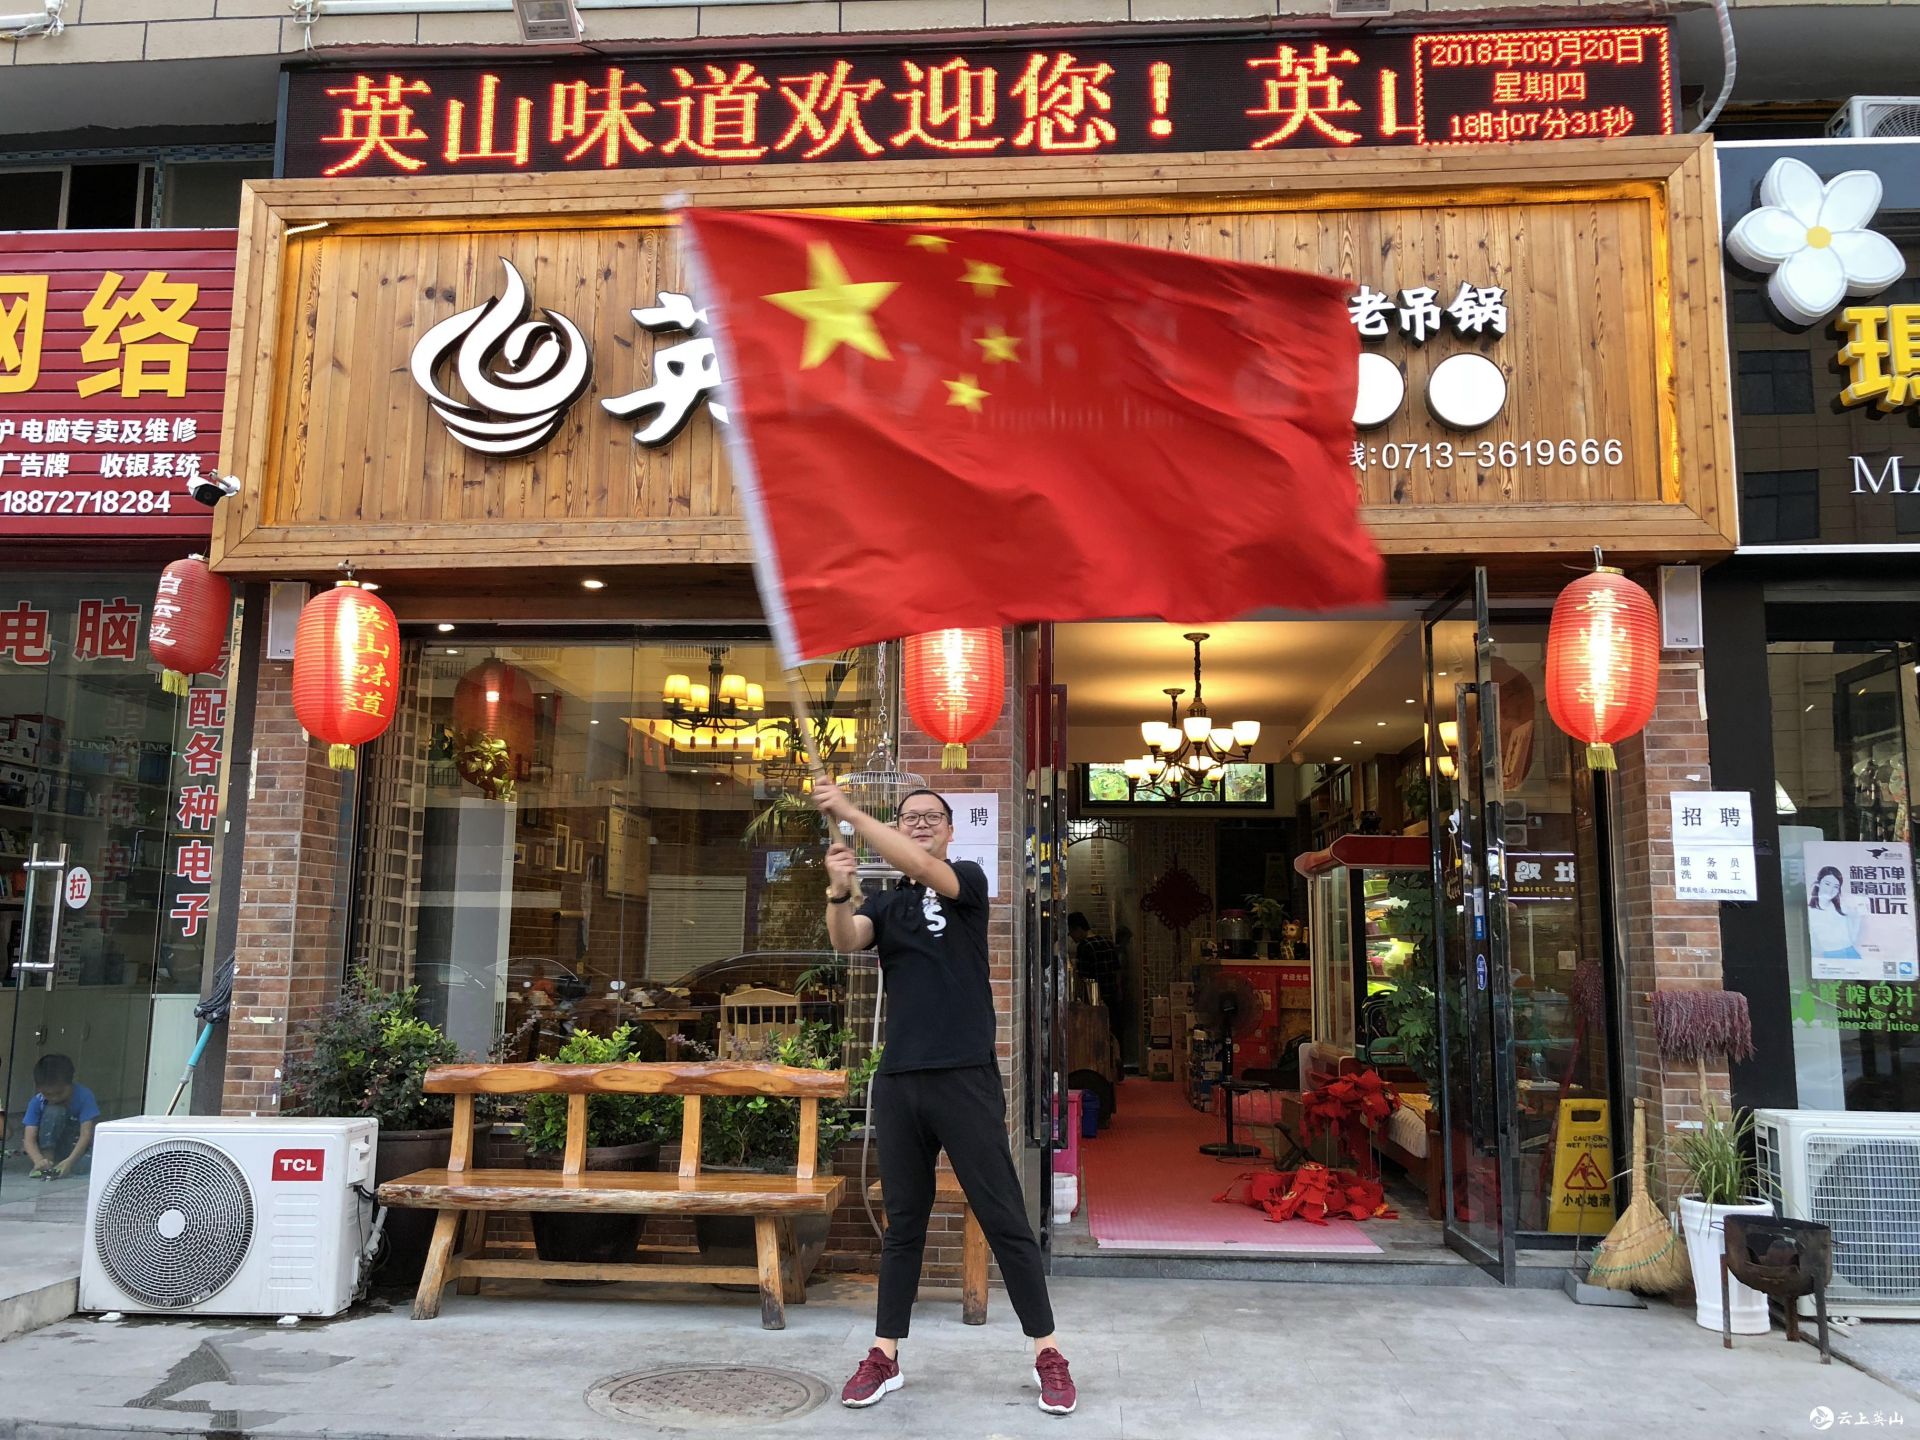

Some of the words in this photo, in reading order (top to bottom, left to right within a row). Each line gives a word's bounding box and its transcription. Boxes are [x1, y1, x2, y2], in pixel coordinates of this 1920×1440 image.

[1430, 35, 1645, 67] 2018年09月20日
[1492, 70, 1587, 103] 星期四
[320, 52, 1173, 177] 英山味道欢迎您！
[1450, 108, 1634, 140] 18时07分31秒
[1349, 281, 1508, 342] 老吊锅
[21, 418, 197, 443] 电脑专卖及维修
[0, 453, 70, 478] 广告牌
[100, 453, 201, 478] 收银系统
[0, 490, 171, 513] 18872718284
[0, 597, 142, 665] 电脑
[970, 807, 988, 827] 聘
[1682, 806, 1741, 827] 招聘
[1681, 856, 1740, 868] 服务员
[1849, 865, 1905, 880] 新客下单
[1681, 869, 1741, 881] 洗碗工
[70, 873, 88, 901] 拉
[1850, 881, 1906, 896] 最高立减
[1868, 897, 1909, 915] 10元
[1886, 1021, 1919, 1032] juice
[281, 1159, 317, 1171] TCL
[1563, 1193, 1611, 1207] 小心地滑
